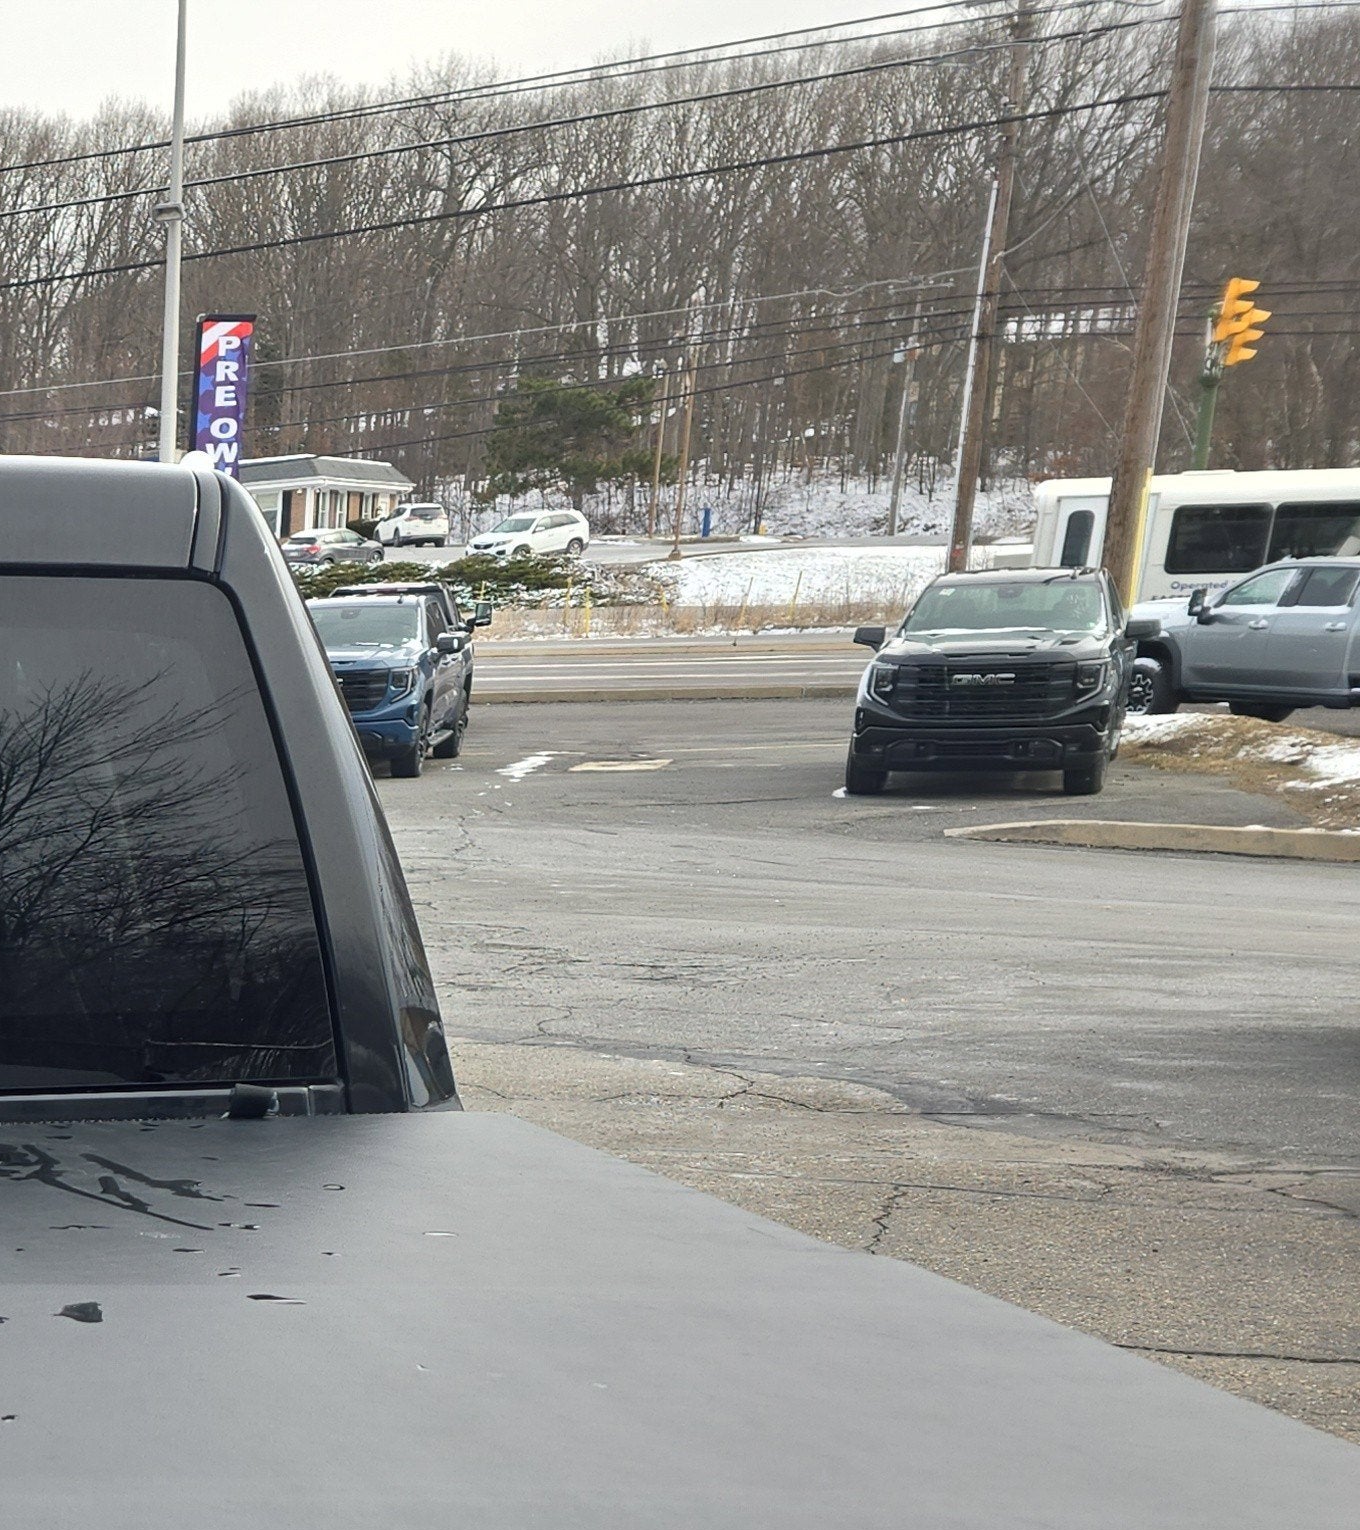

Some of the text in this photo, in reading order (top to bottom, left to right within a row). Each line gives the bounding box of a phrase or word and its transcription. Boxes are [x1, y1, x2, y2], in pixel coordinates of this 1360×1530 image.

[215, 336, 241, 407] PRE
[1170, 581, 1229, 590] Operated
[952, 673, 1016, 686] GMC
